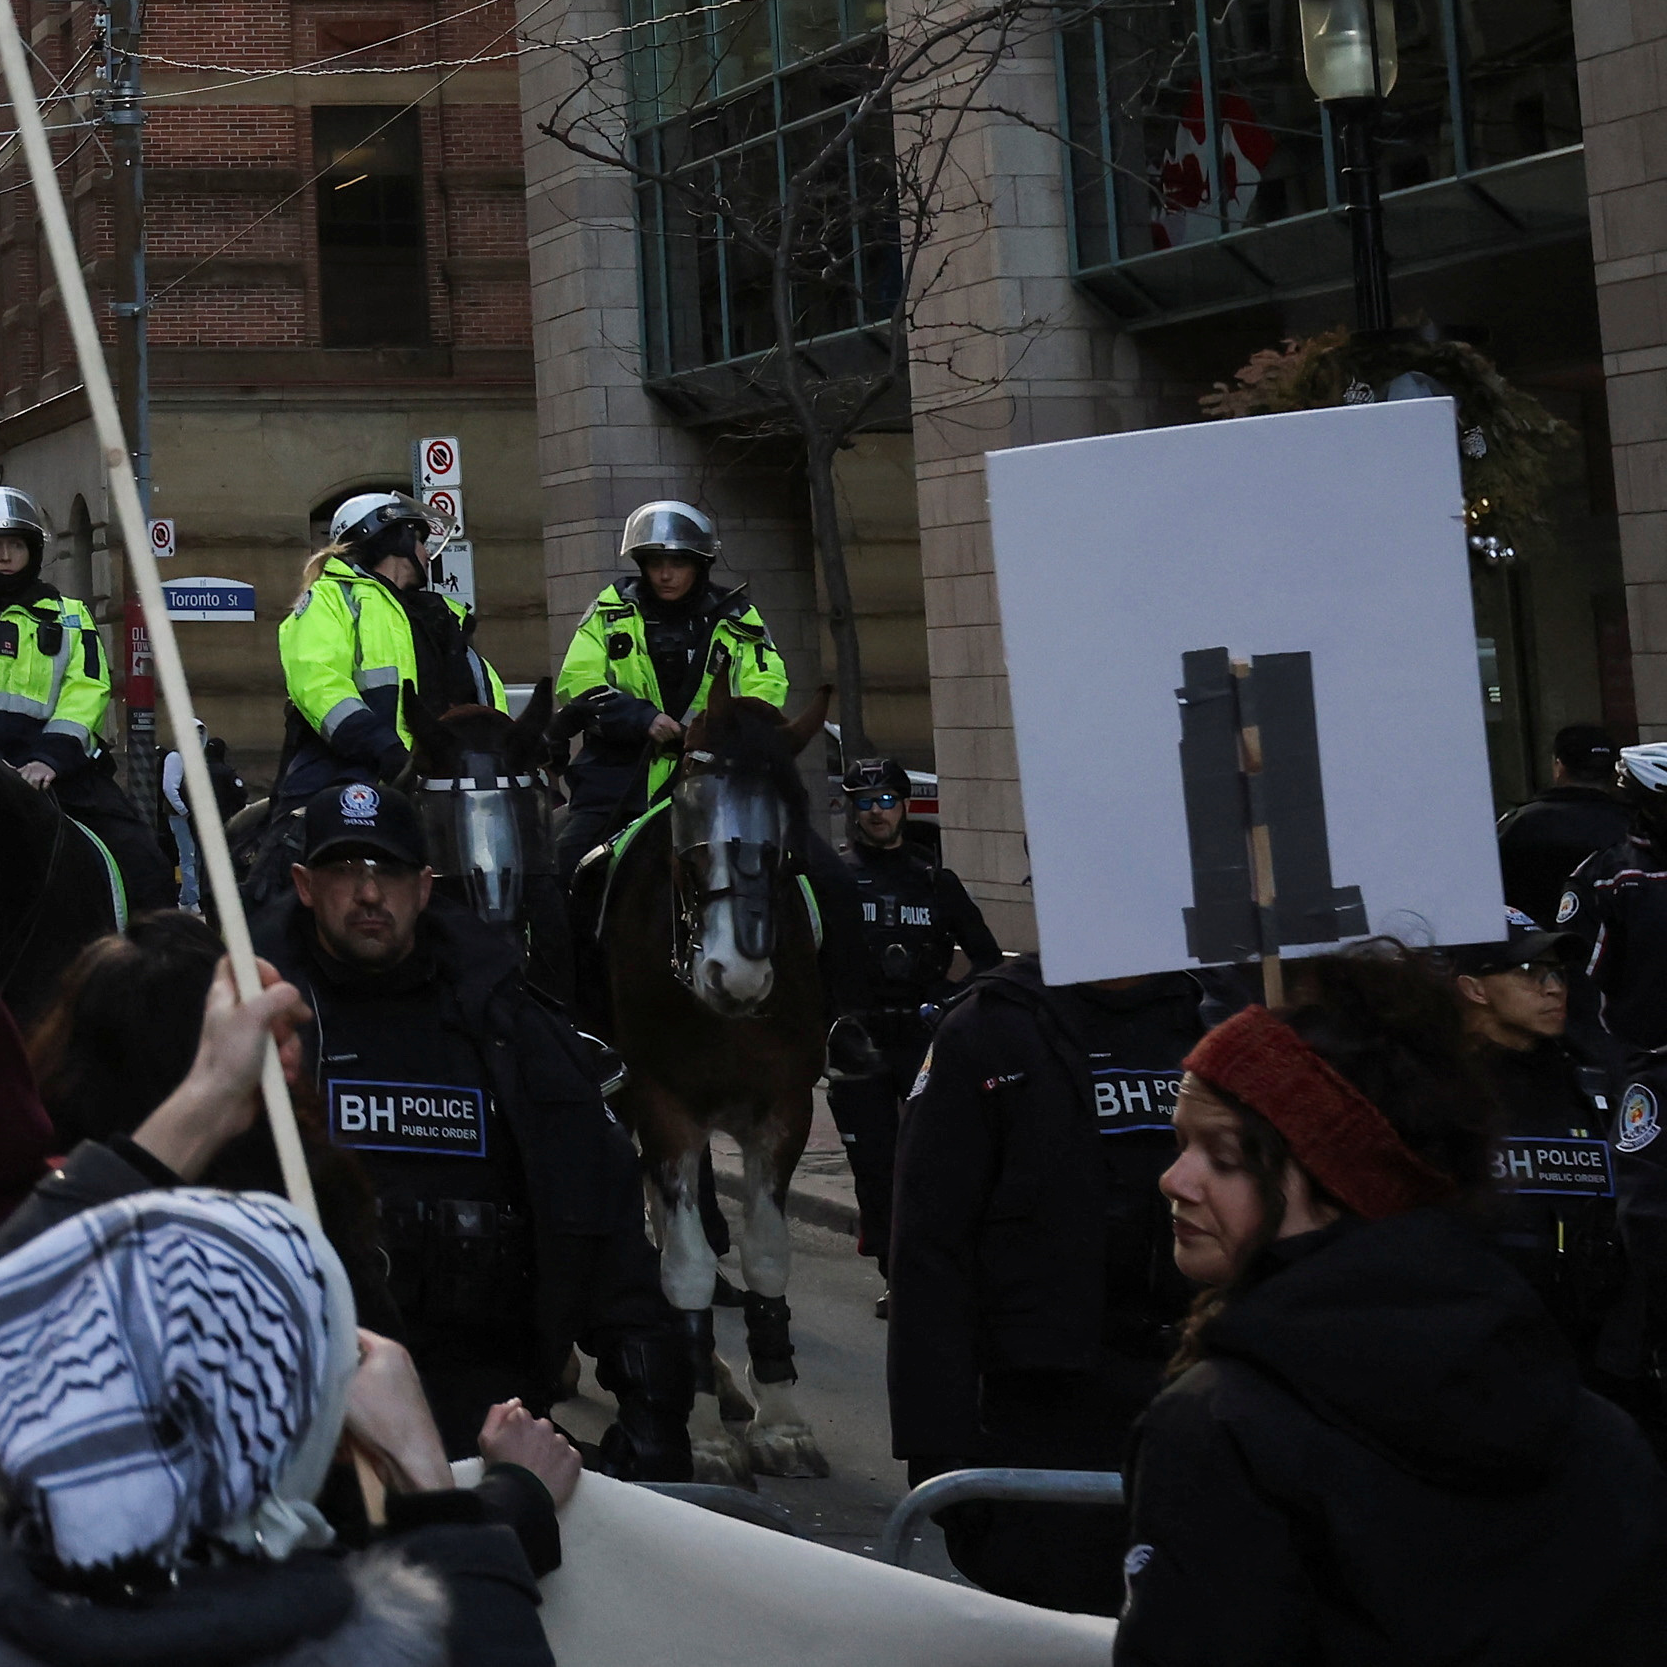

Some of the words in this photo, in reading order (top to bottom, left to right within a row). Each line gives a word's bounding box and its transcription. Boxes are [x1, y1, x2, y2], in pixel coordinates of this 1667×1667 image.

[169, 591, 220, 607] Toronto
[227, 594, 239, 607] St
[202, 611, 207, 620] 1
[132, 626, 150, 641] OL
[900, 905, 932, 926] POLICE
[1093, 1079, 1152, 1118] BH
[339, 1093, 396, 1133] BH
[402, 1096, 476, 1120] POLICE
[402, 1124, 440, 1138] PUBLIC
[441, 1127, 478, 1141] ORDER
[1535, 1148, 1603, 1168] POLICE
[1538, 1170, 1574, 1183] PUBLIC
[1574, 1172, 1608, 1184] ORDER
